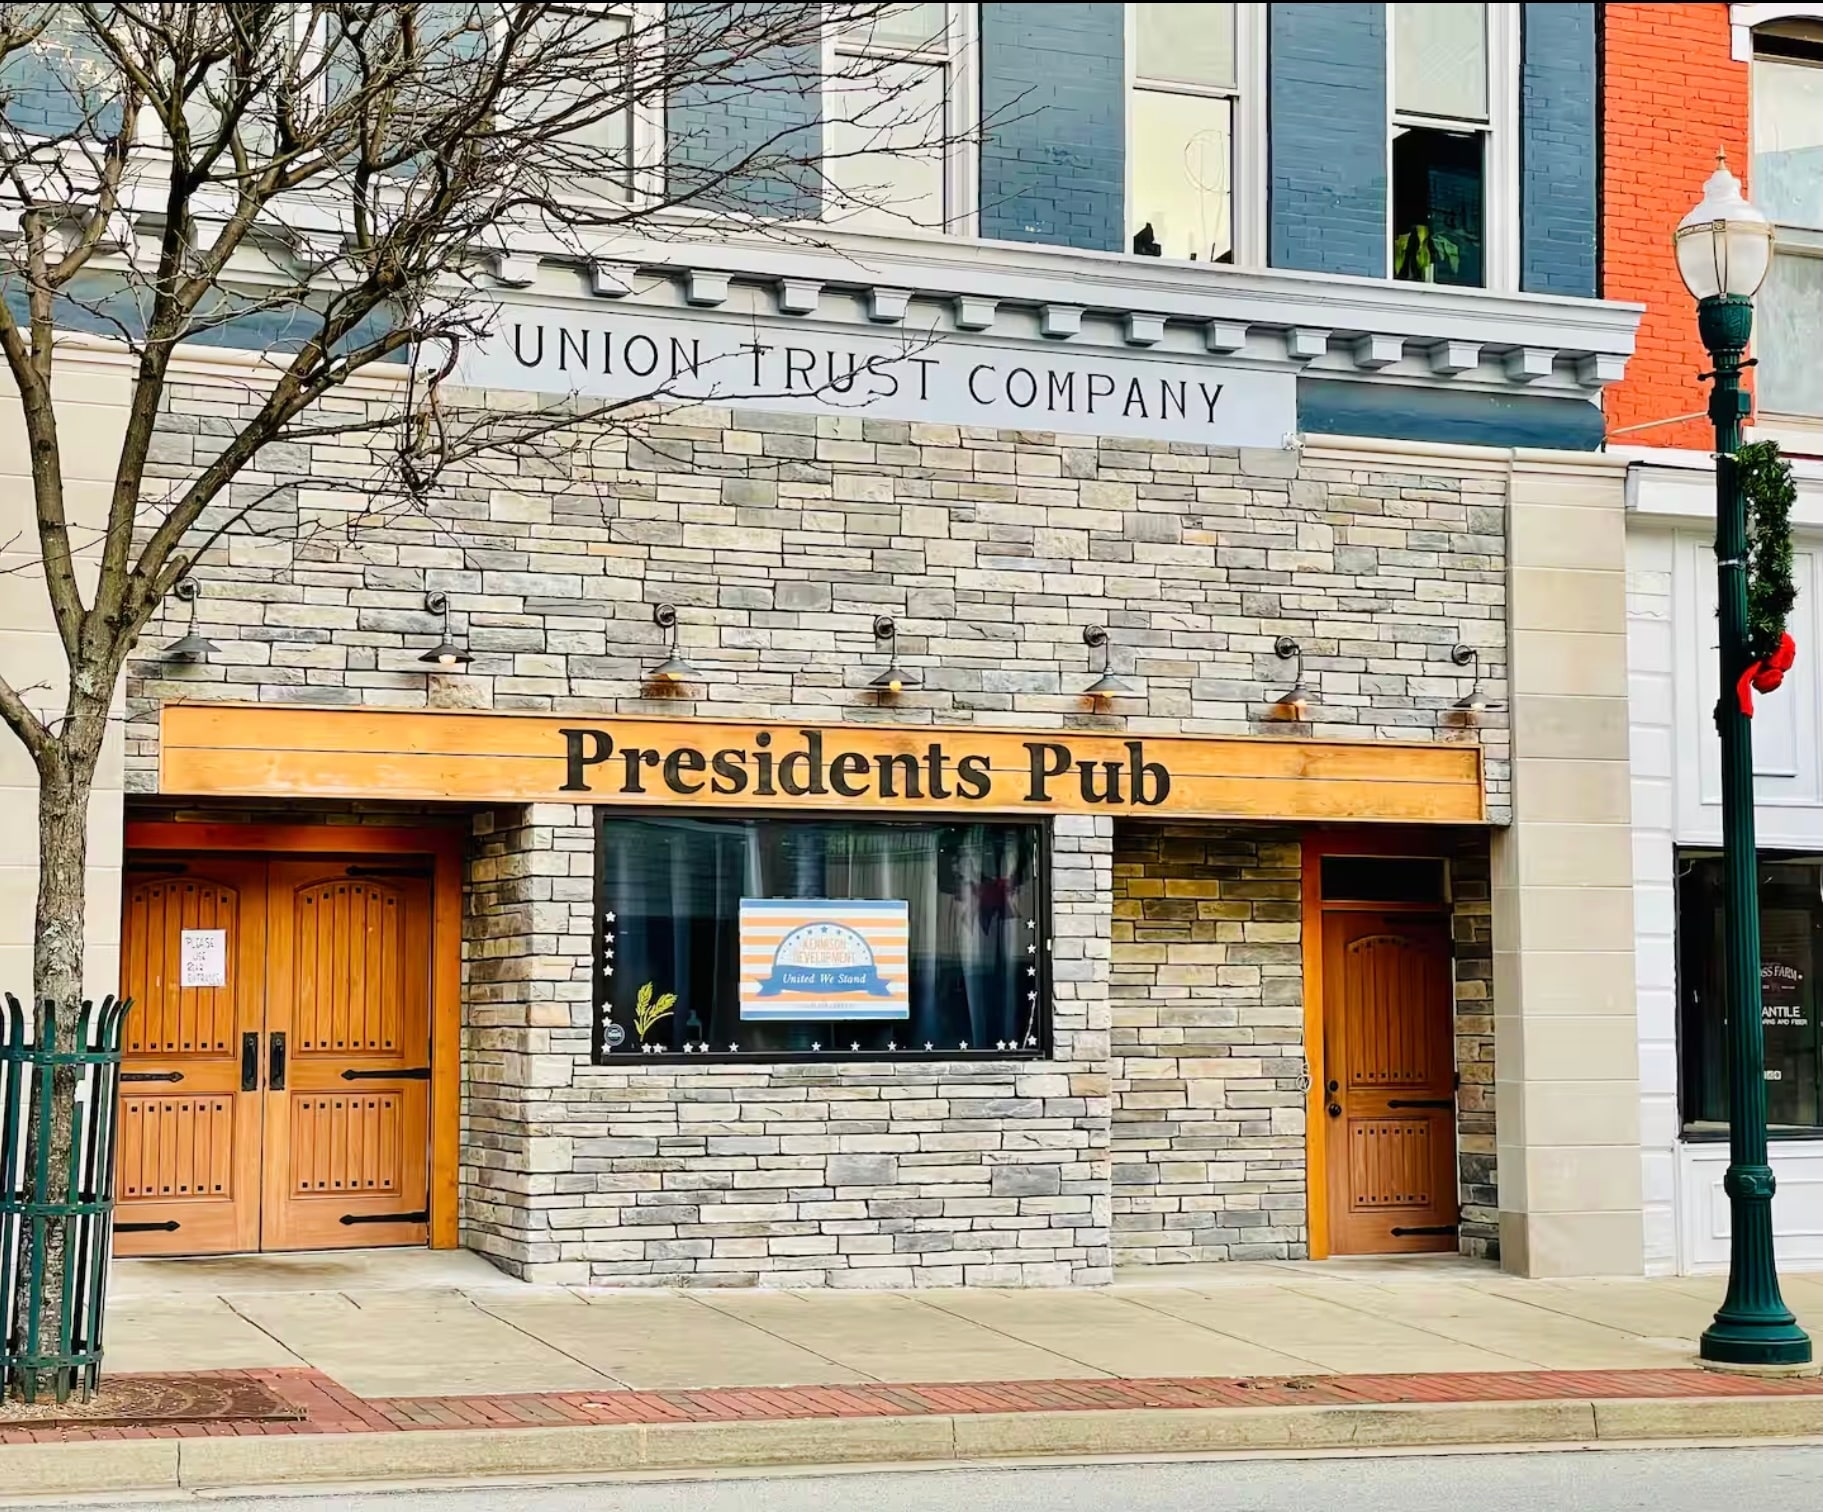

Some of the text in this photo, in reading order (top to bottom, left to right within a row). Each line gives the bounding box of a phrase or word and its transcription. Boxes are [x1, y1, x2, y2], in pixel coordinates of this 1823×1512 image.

[514, 323, 1224, 424] UNION TRUST COMPANY
[558, 728, 1171, 806] Presidents Pub
[782, 973, 866, 984] United We Stand
[1761, 1005, 1801, 1018] ANTILE
